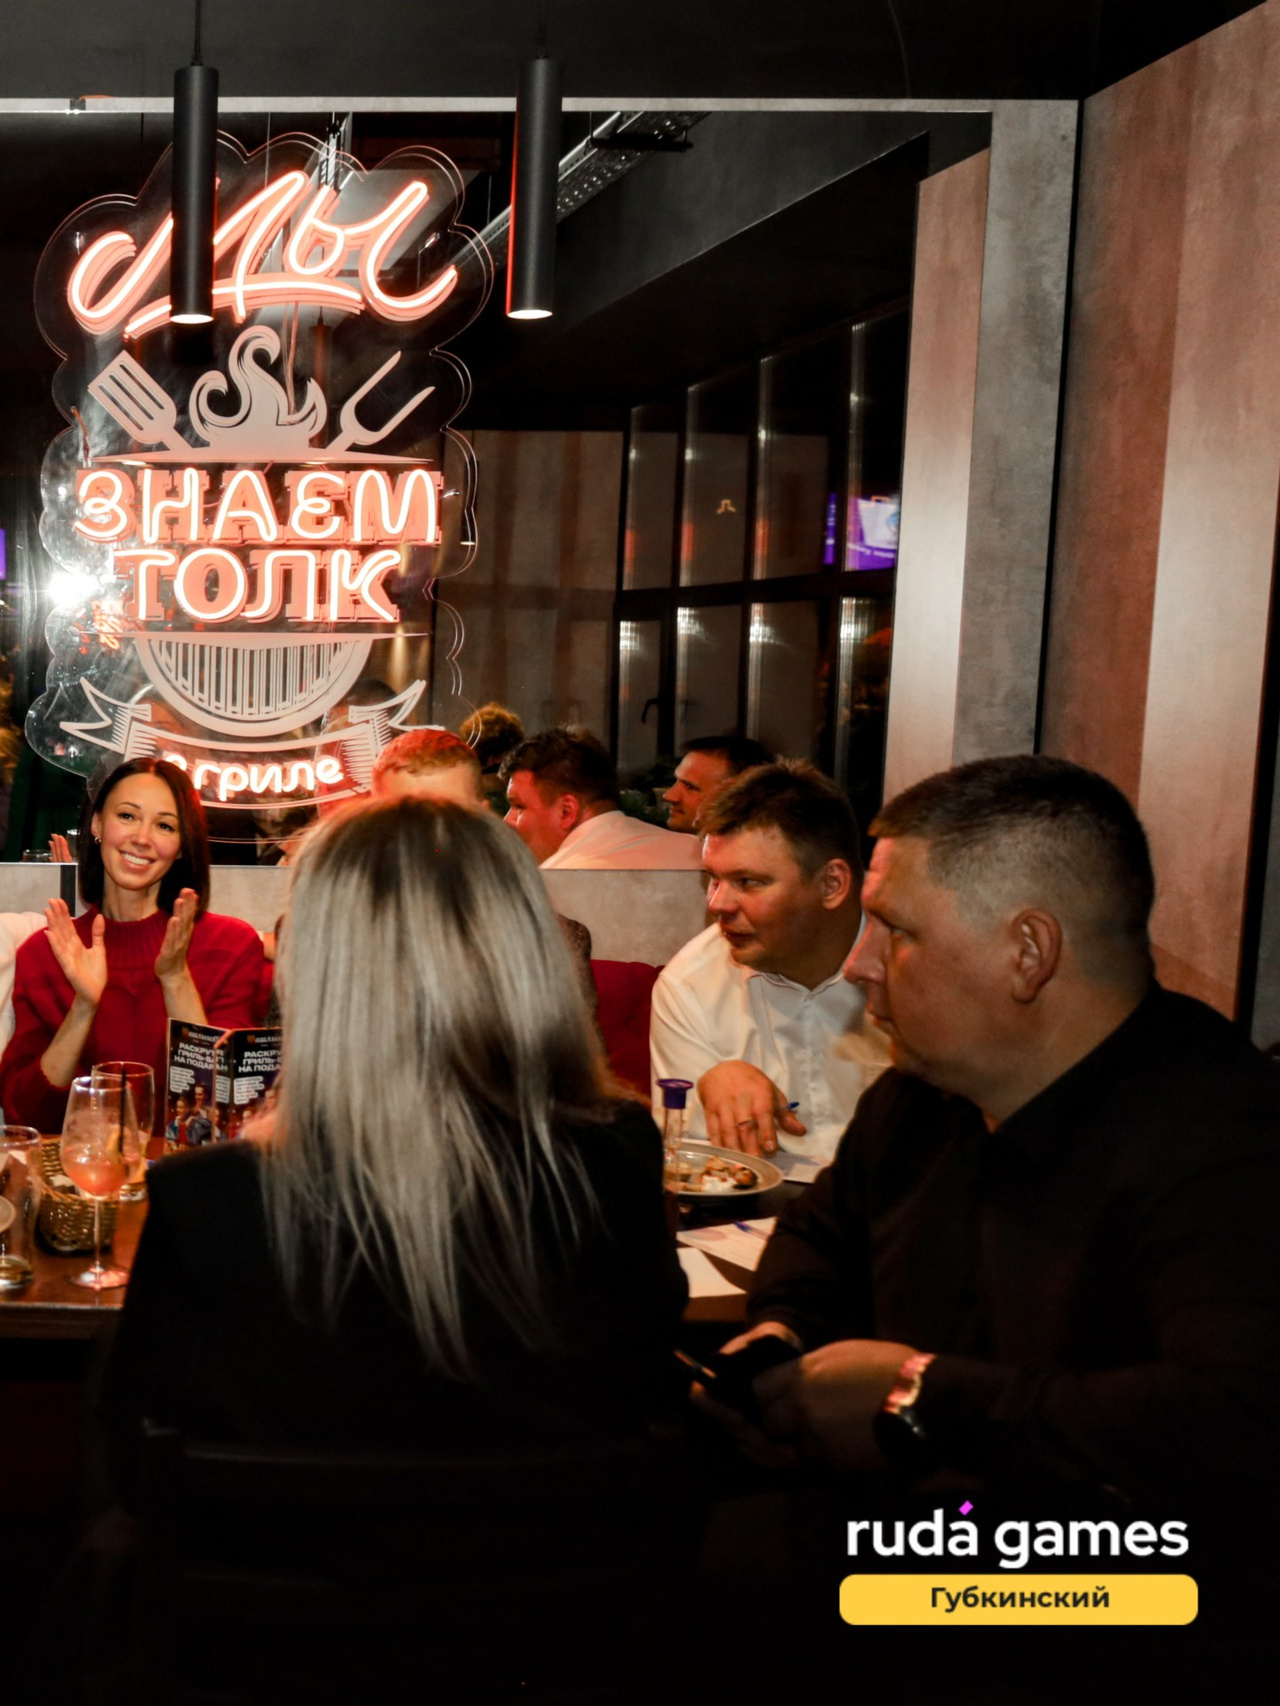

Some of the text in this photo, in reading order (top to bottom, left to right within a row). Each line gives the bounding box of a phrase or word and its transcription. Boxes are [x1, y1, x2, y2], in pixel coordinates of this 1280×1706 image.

[74, 467, 444, 545] ЗНАЕМ
[113, 548, 402, 622] ТОЛК
[193, 755, 345, 802] гриле
